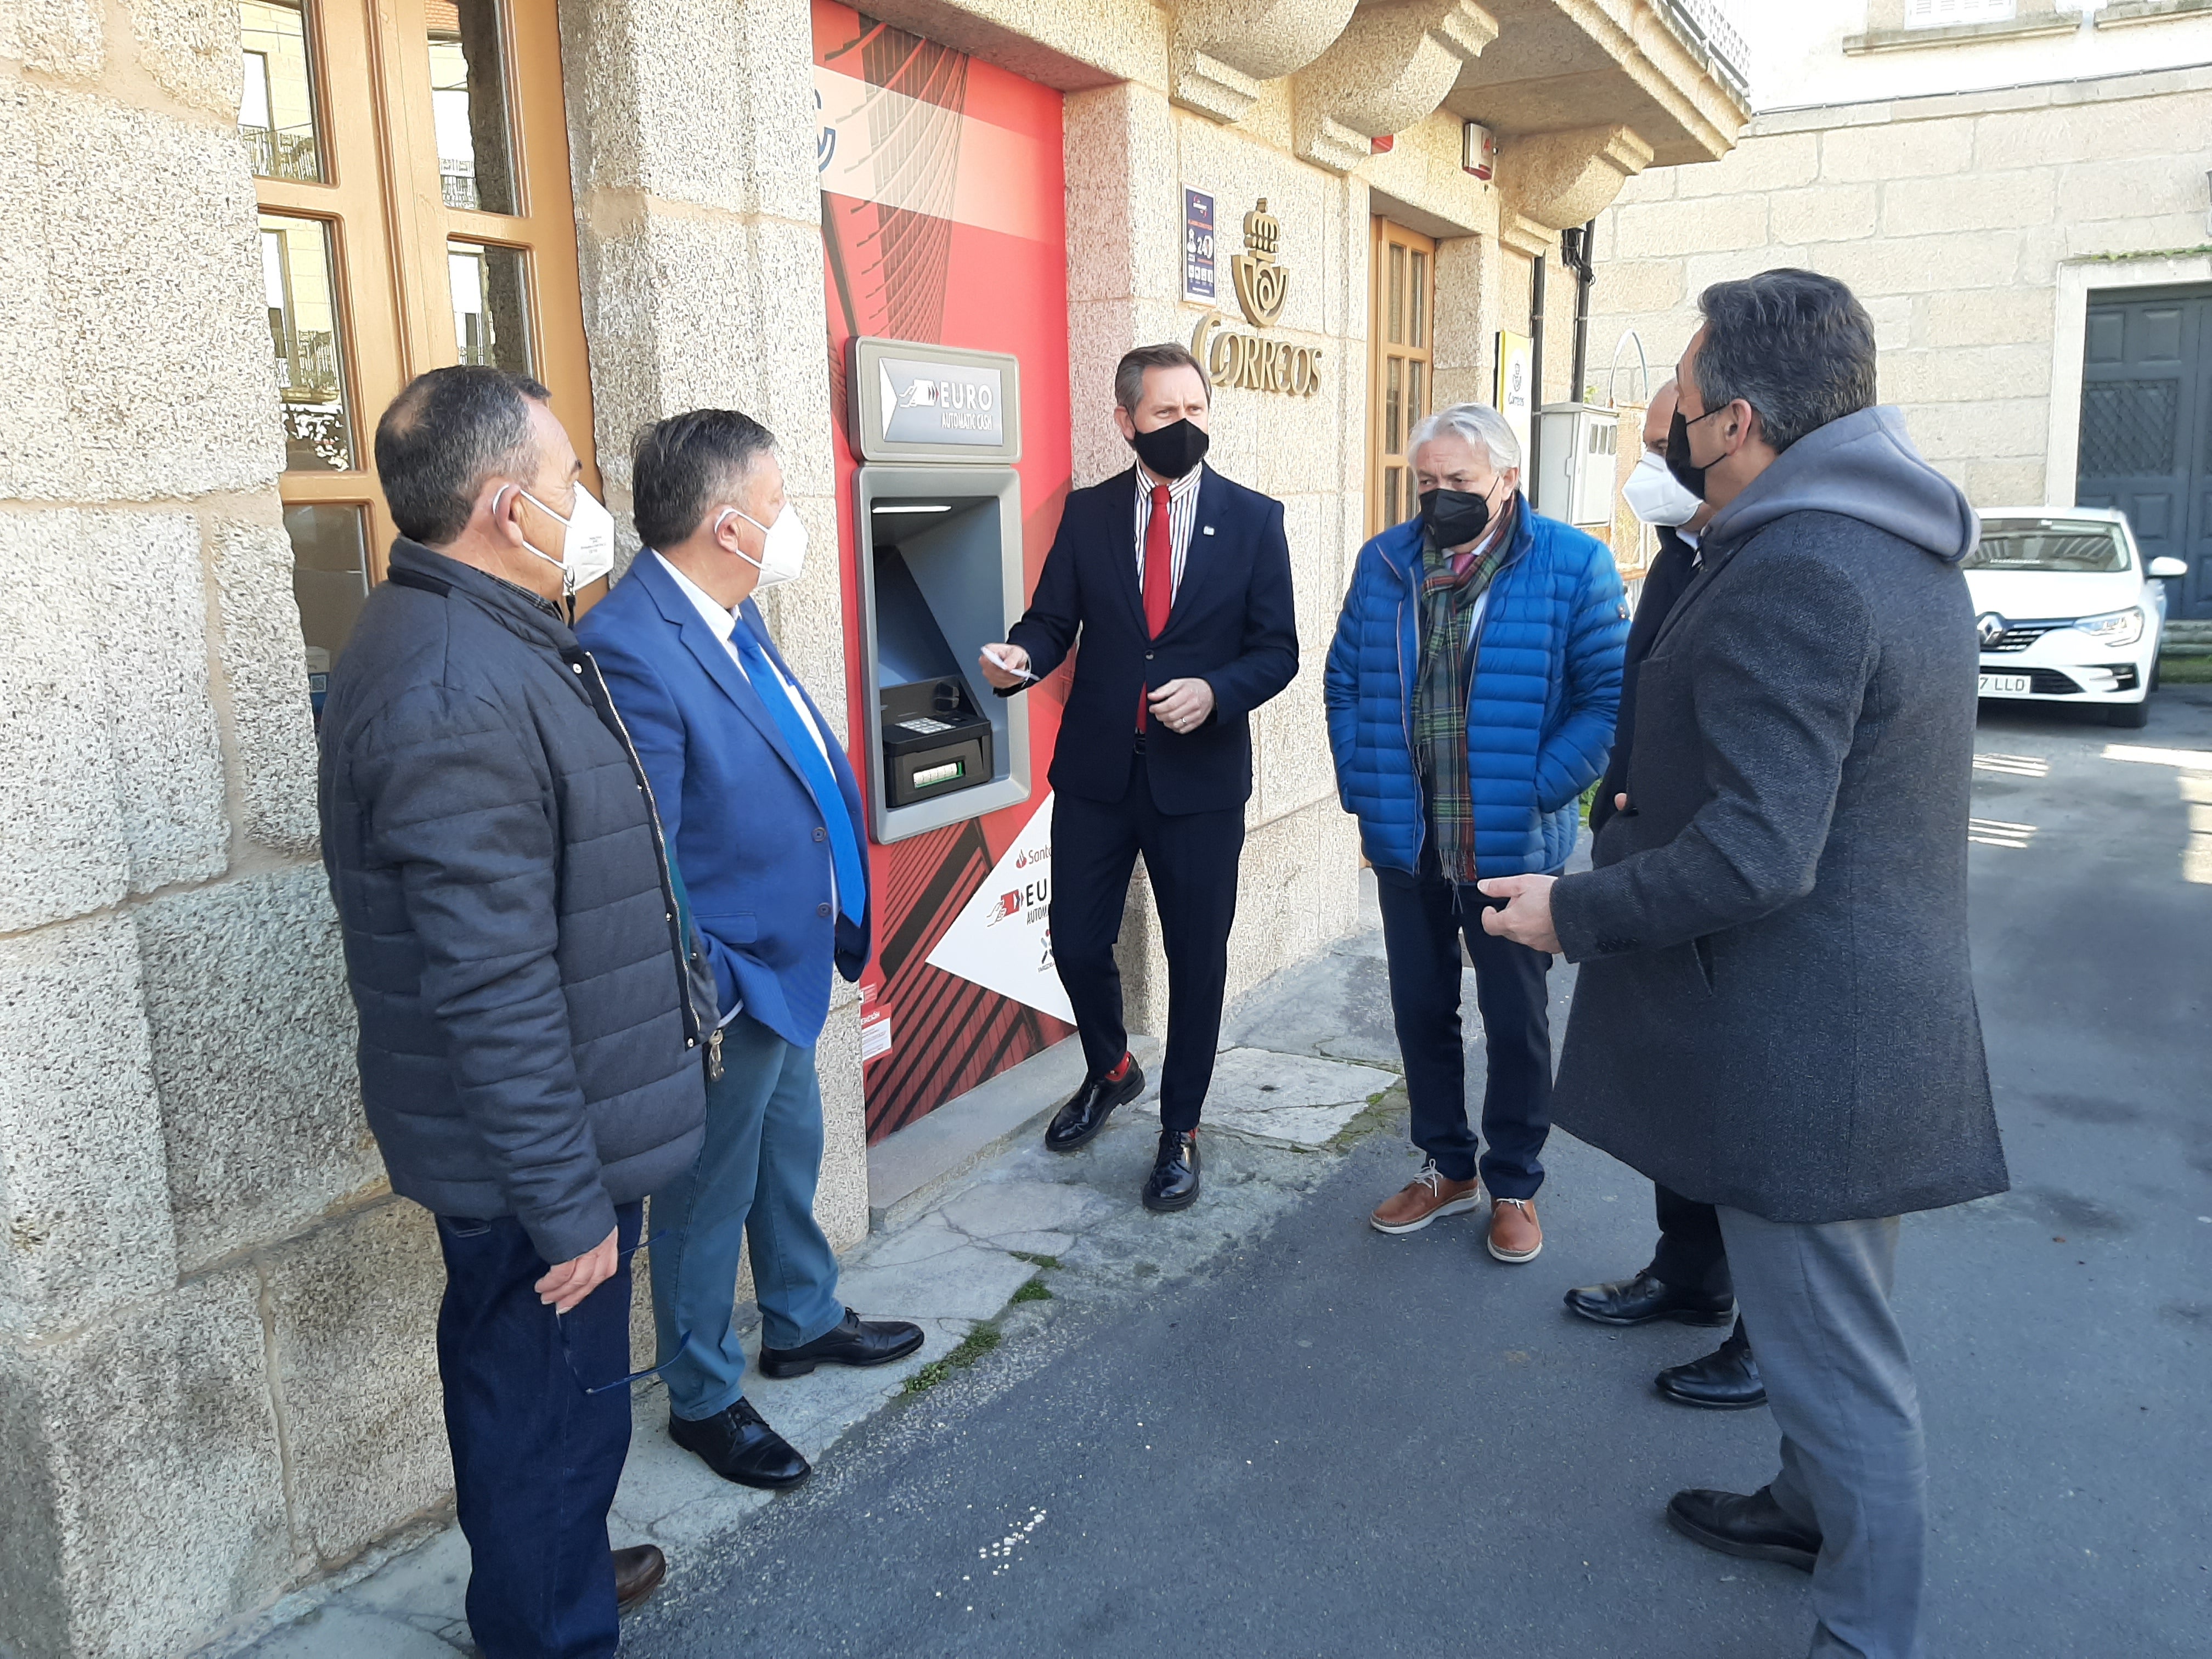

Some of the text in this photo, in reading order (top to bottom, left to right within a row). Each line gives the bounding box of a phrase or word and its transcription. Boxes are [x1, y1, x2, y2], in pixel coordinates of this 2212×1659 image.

[940, 381, 993, 411] EURO
[977, 414, 992, 430] CASH
[1995, 678, 2024, 691] LLD
[1026, 878, 1047, 907] EU
[1026, 904, 1049, 926] AUTOM
